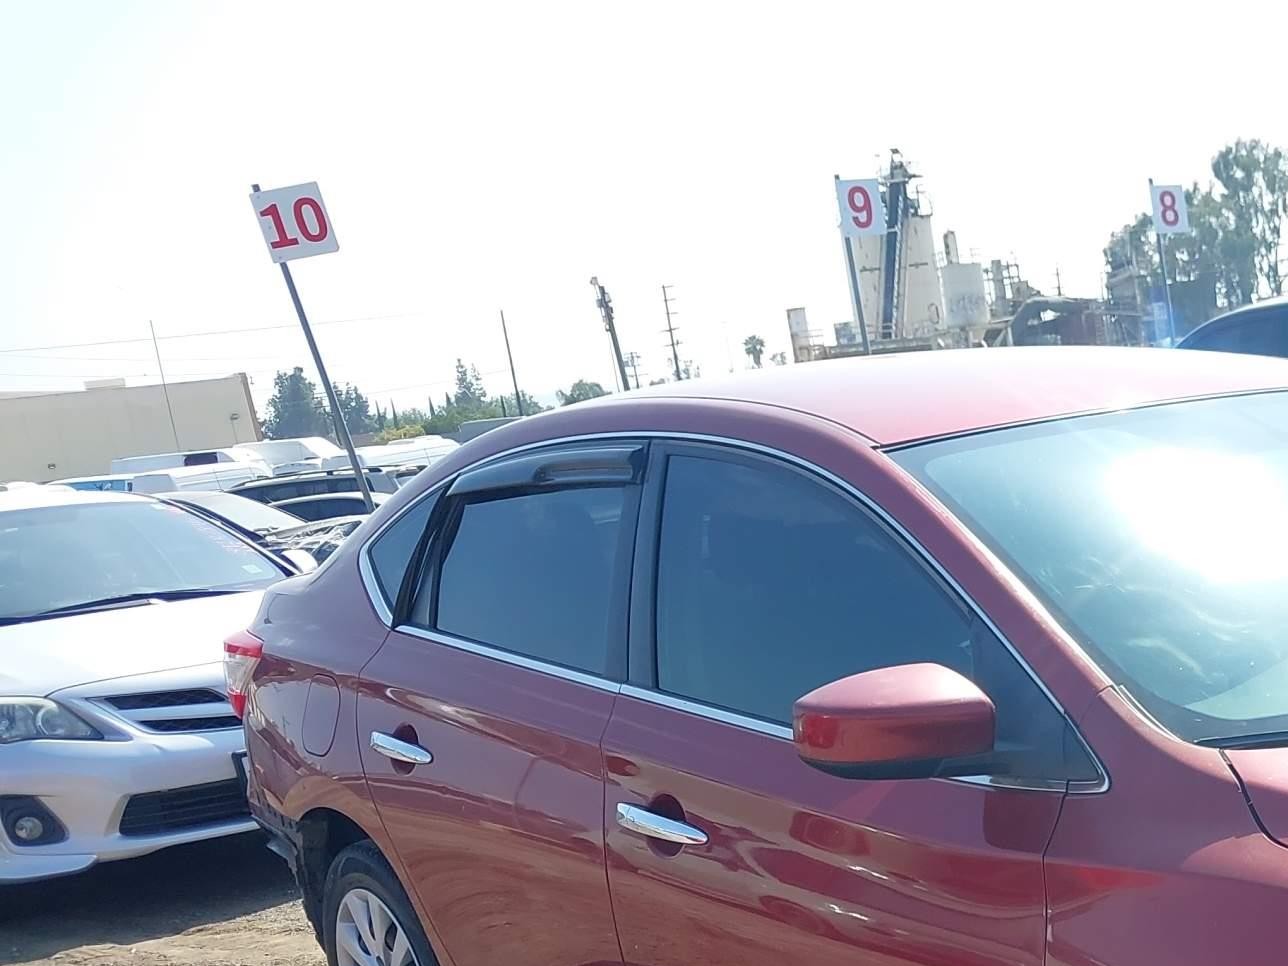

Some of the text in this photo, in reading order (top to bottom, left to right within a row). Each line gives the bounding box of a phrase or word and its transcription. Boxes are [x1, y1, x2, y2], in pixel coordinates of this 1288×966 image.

[260, 197, 328, 249] 10
[848, 187, 872, 228] 9
[1160, 190, 1179, 227] 8
